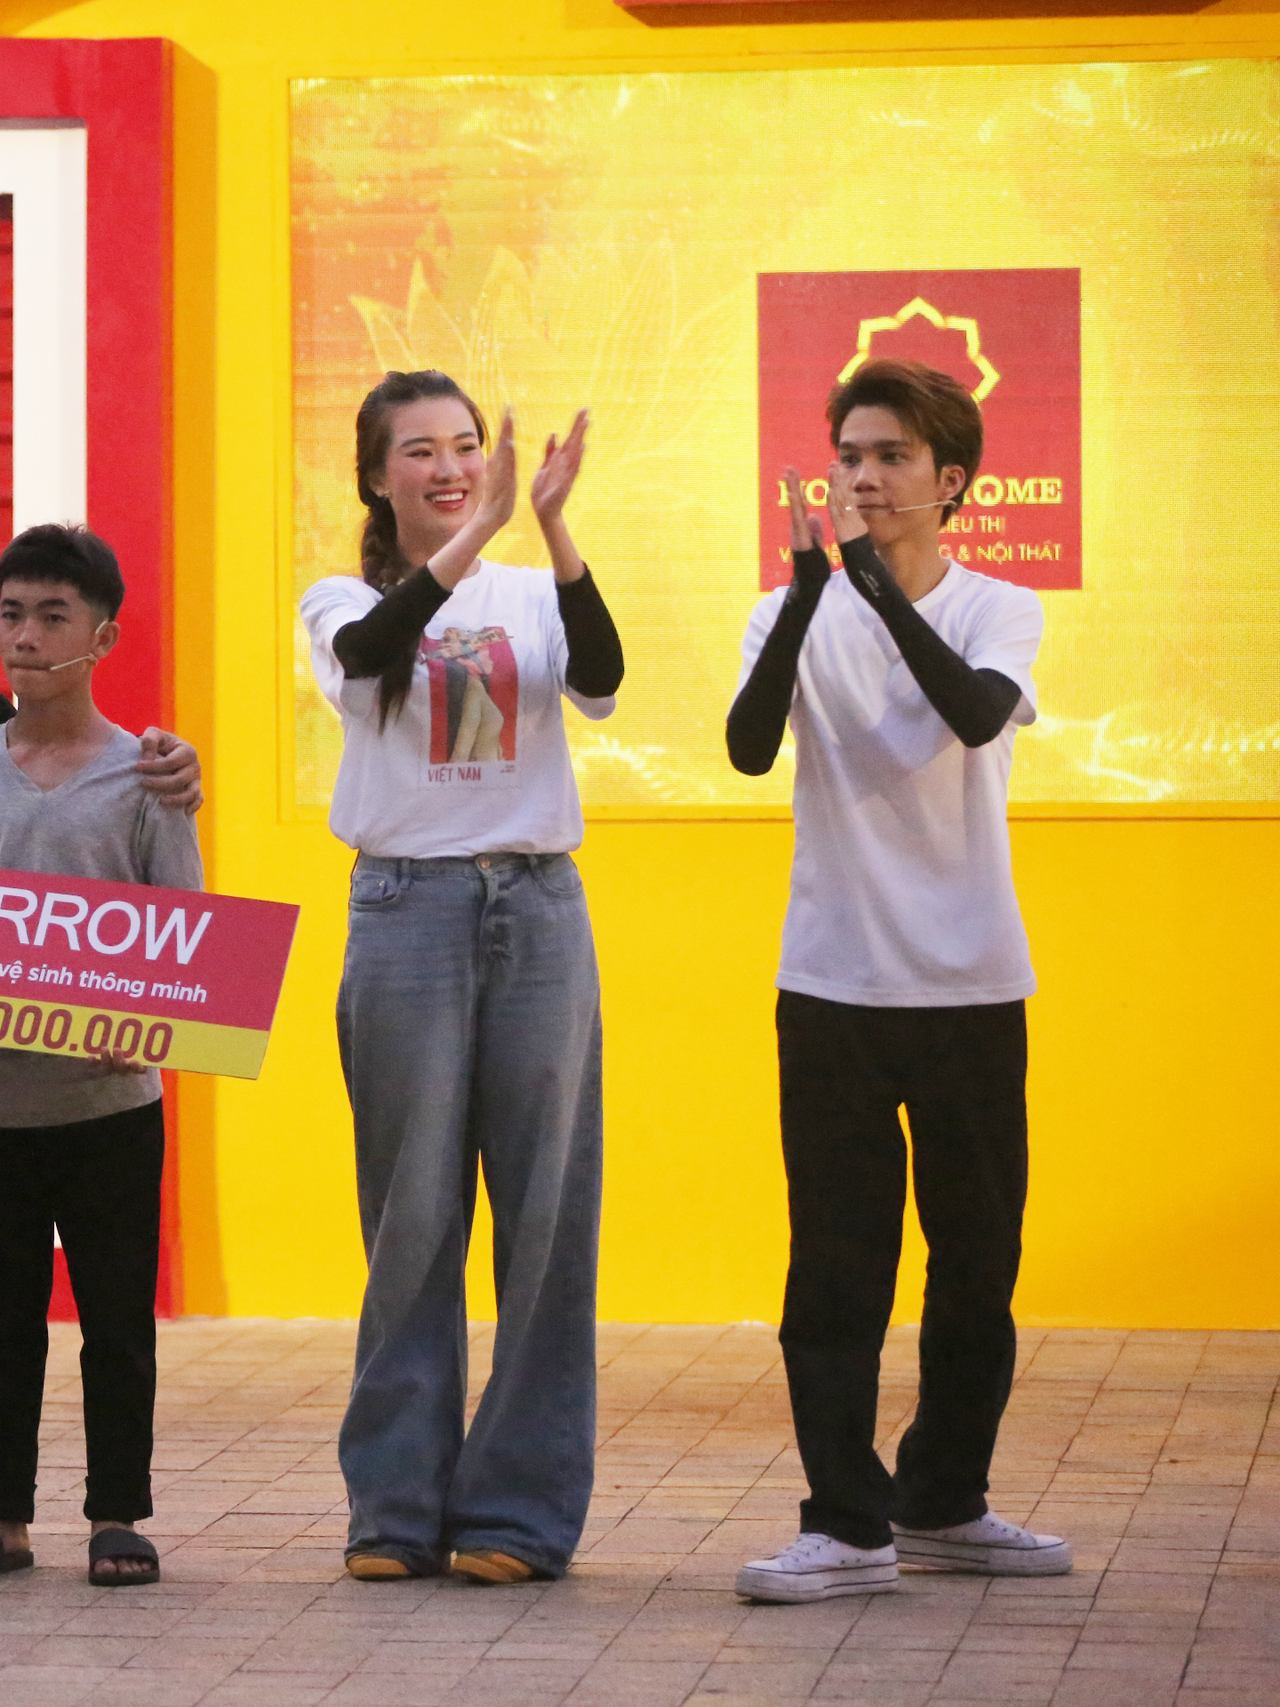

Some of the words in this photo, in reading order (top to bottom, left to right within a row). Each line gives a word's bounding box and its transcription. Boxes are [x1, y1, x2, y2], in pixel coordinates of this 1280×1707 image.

[963, 474, 1063, 507] OME
[457, 766, 482, 781] NAM
[27, 963, 74, 985] sinh
[79, 970, 146, 998] thông
[150, 980, 208, 1003] minh
